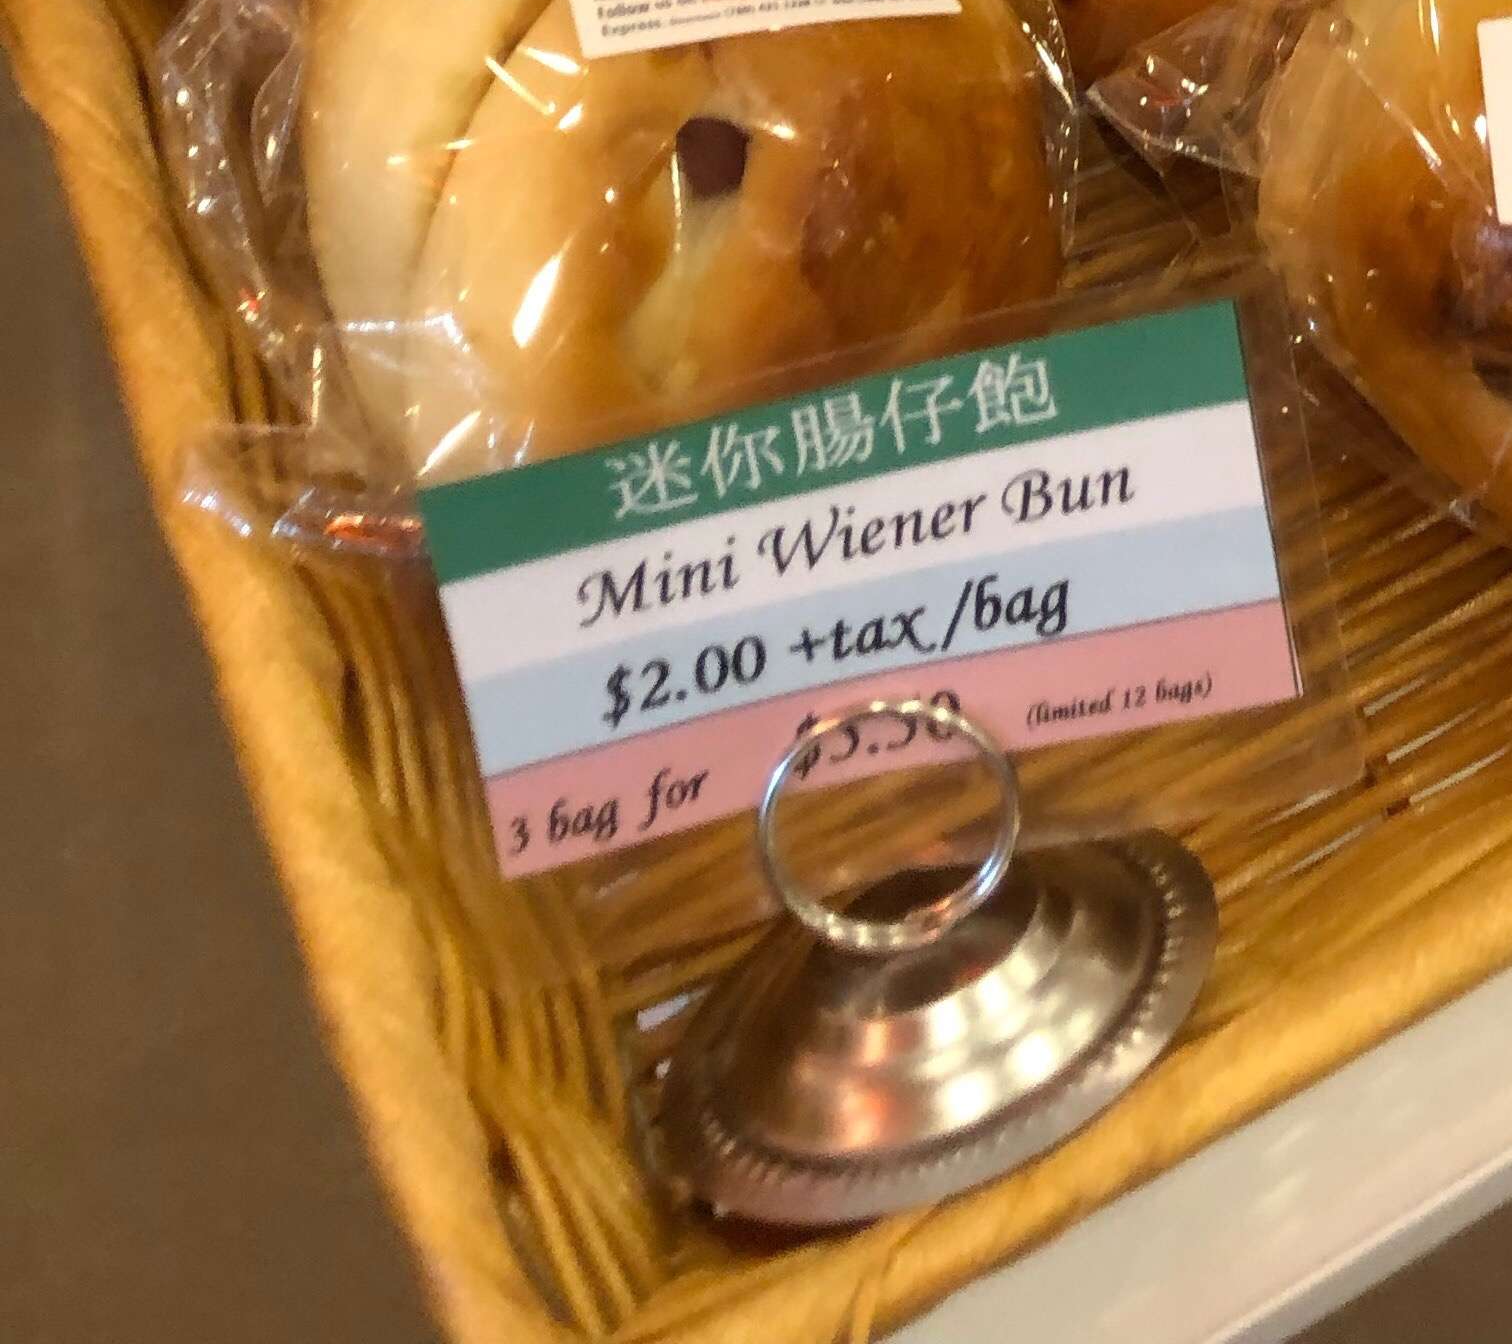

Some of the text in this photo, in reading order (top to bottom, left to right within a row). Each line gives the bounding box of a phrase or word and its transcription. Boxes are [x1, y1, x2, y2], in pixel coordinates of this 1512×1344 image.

[603, 351, 1059, 519] 迷你腸仔飽
[577, 462, 1135, 628] Mini Wiener Bun
[602, 634, 768, 730] $2.00
[509, 814, 532, 857] 3
[545, 796, 620, 844] bag
[638, 766, 710, 832] for
[1121, 684, 1147, 712] 12
